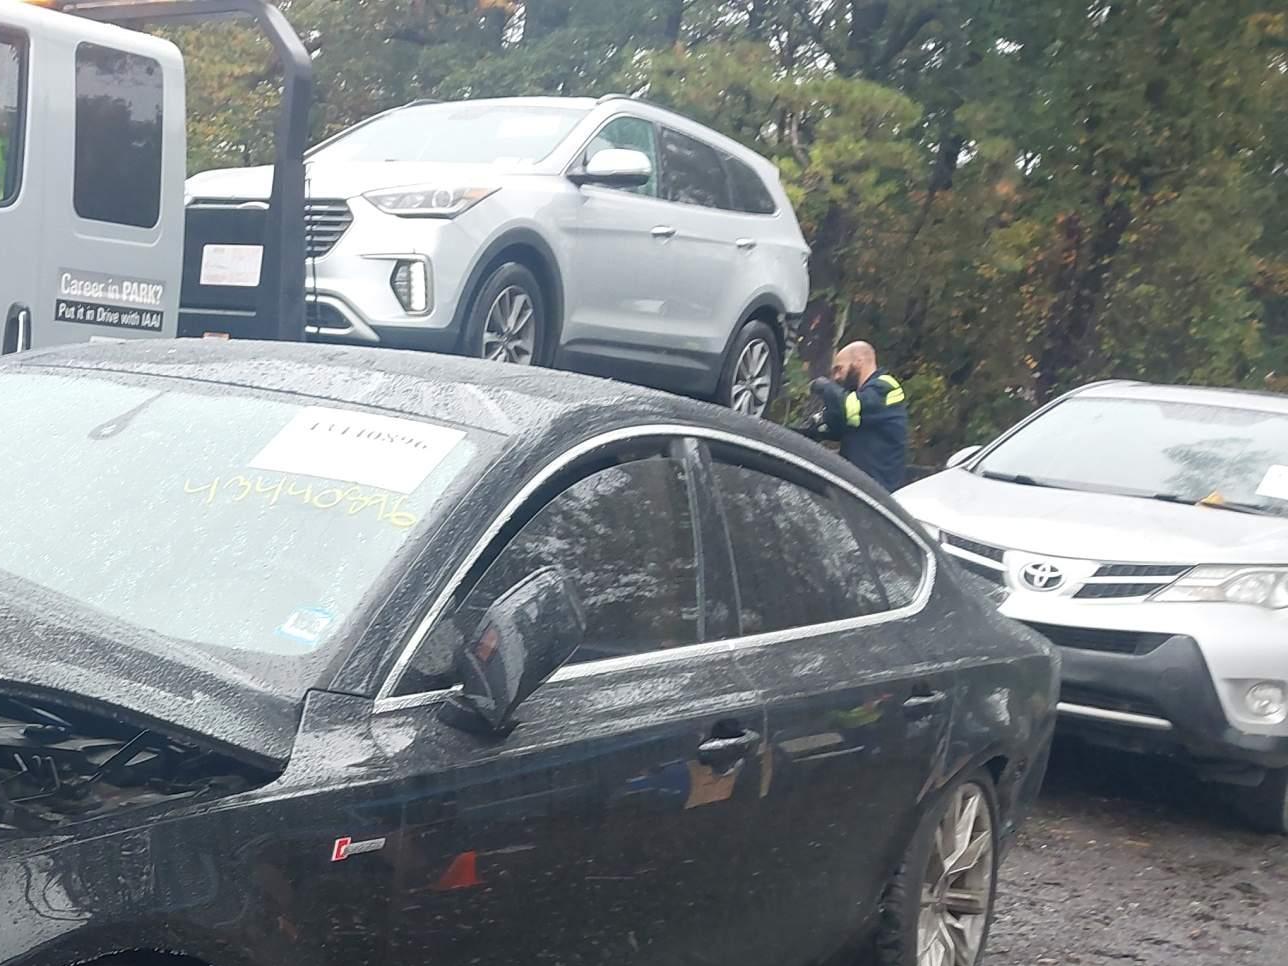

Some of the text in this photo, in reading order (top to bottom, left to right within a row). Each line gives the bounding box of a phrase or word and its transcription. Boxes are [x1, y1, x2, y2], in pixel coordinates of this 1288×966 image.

[61, 272, 163, 305] Career in PARK?
[58, 302, 75, 319] Put
[76, 304, 85, 319] it
[86, 306, 95, 320] in
[96, 307, 120, 324] Drive
[121, 311, 140, 326] with
